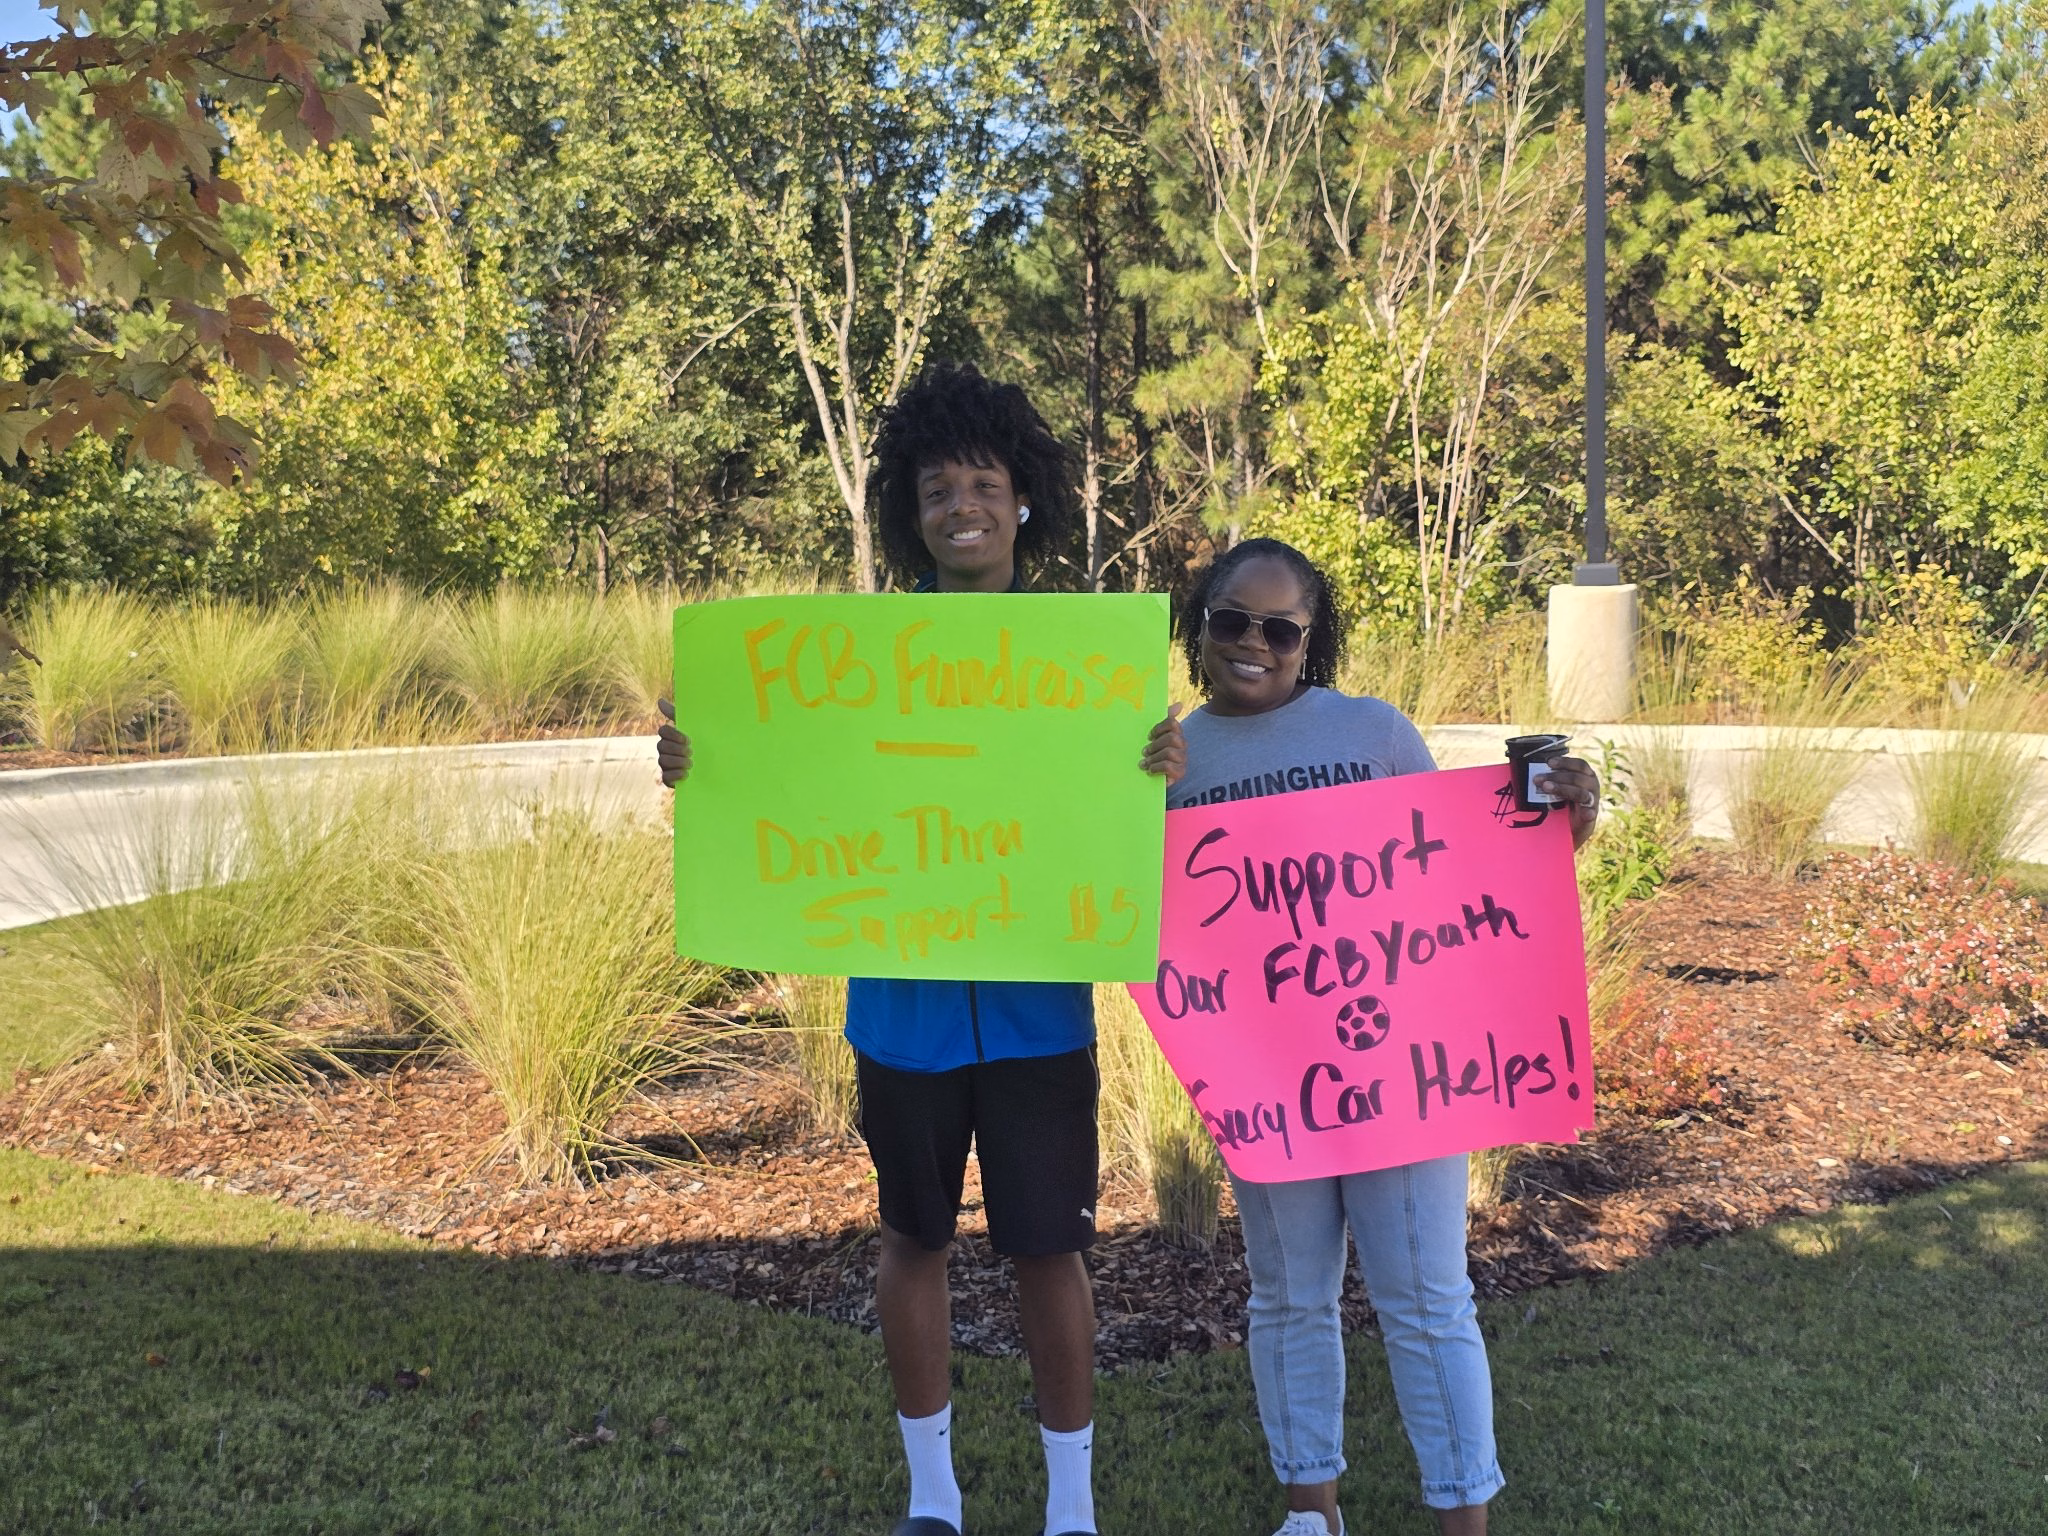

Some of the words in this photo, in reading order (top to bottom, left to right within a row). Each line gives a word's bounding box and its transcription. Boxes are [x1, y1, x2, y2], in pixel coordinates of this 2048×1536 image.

[744, 618, 878, 723] FCB
[894, 619, 1158, 715] Fundraiser
[755, 817, 899, 884] Drive
[894, 805, 1024, 872] Thru
[1185, 807, 1449, 940] Support
[803, 874, 1028, 962] Support
[1063, 881, 1140, 947] $5
[1156, 959, 1230, 1019] Our
[1263, 936, 1370, 1003] FCB
[1370, 893, 1530, 985] Youth
[1300, 1062, 1386, 1132] Car
[1409, 1014, 1580, 1121] Helps!
